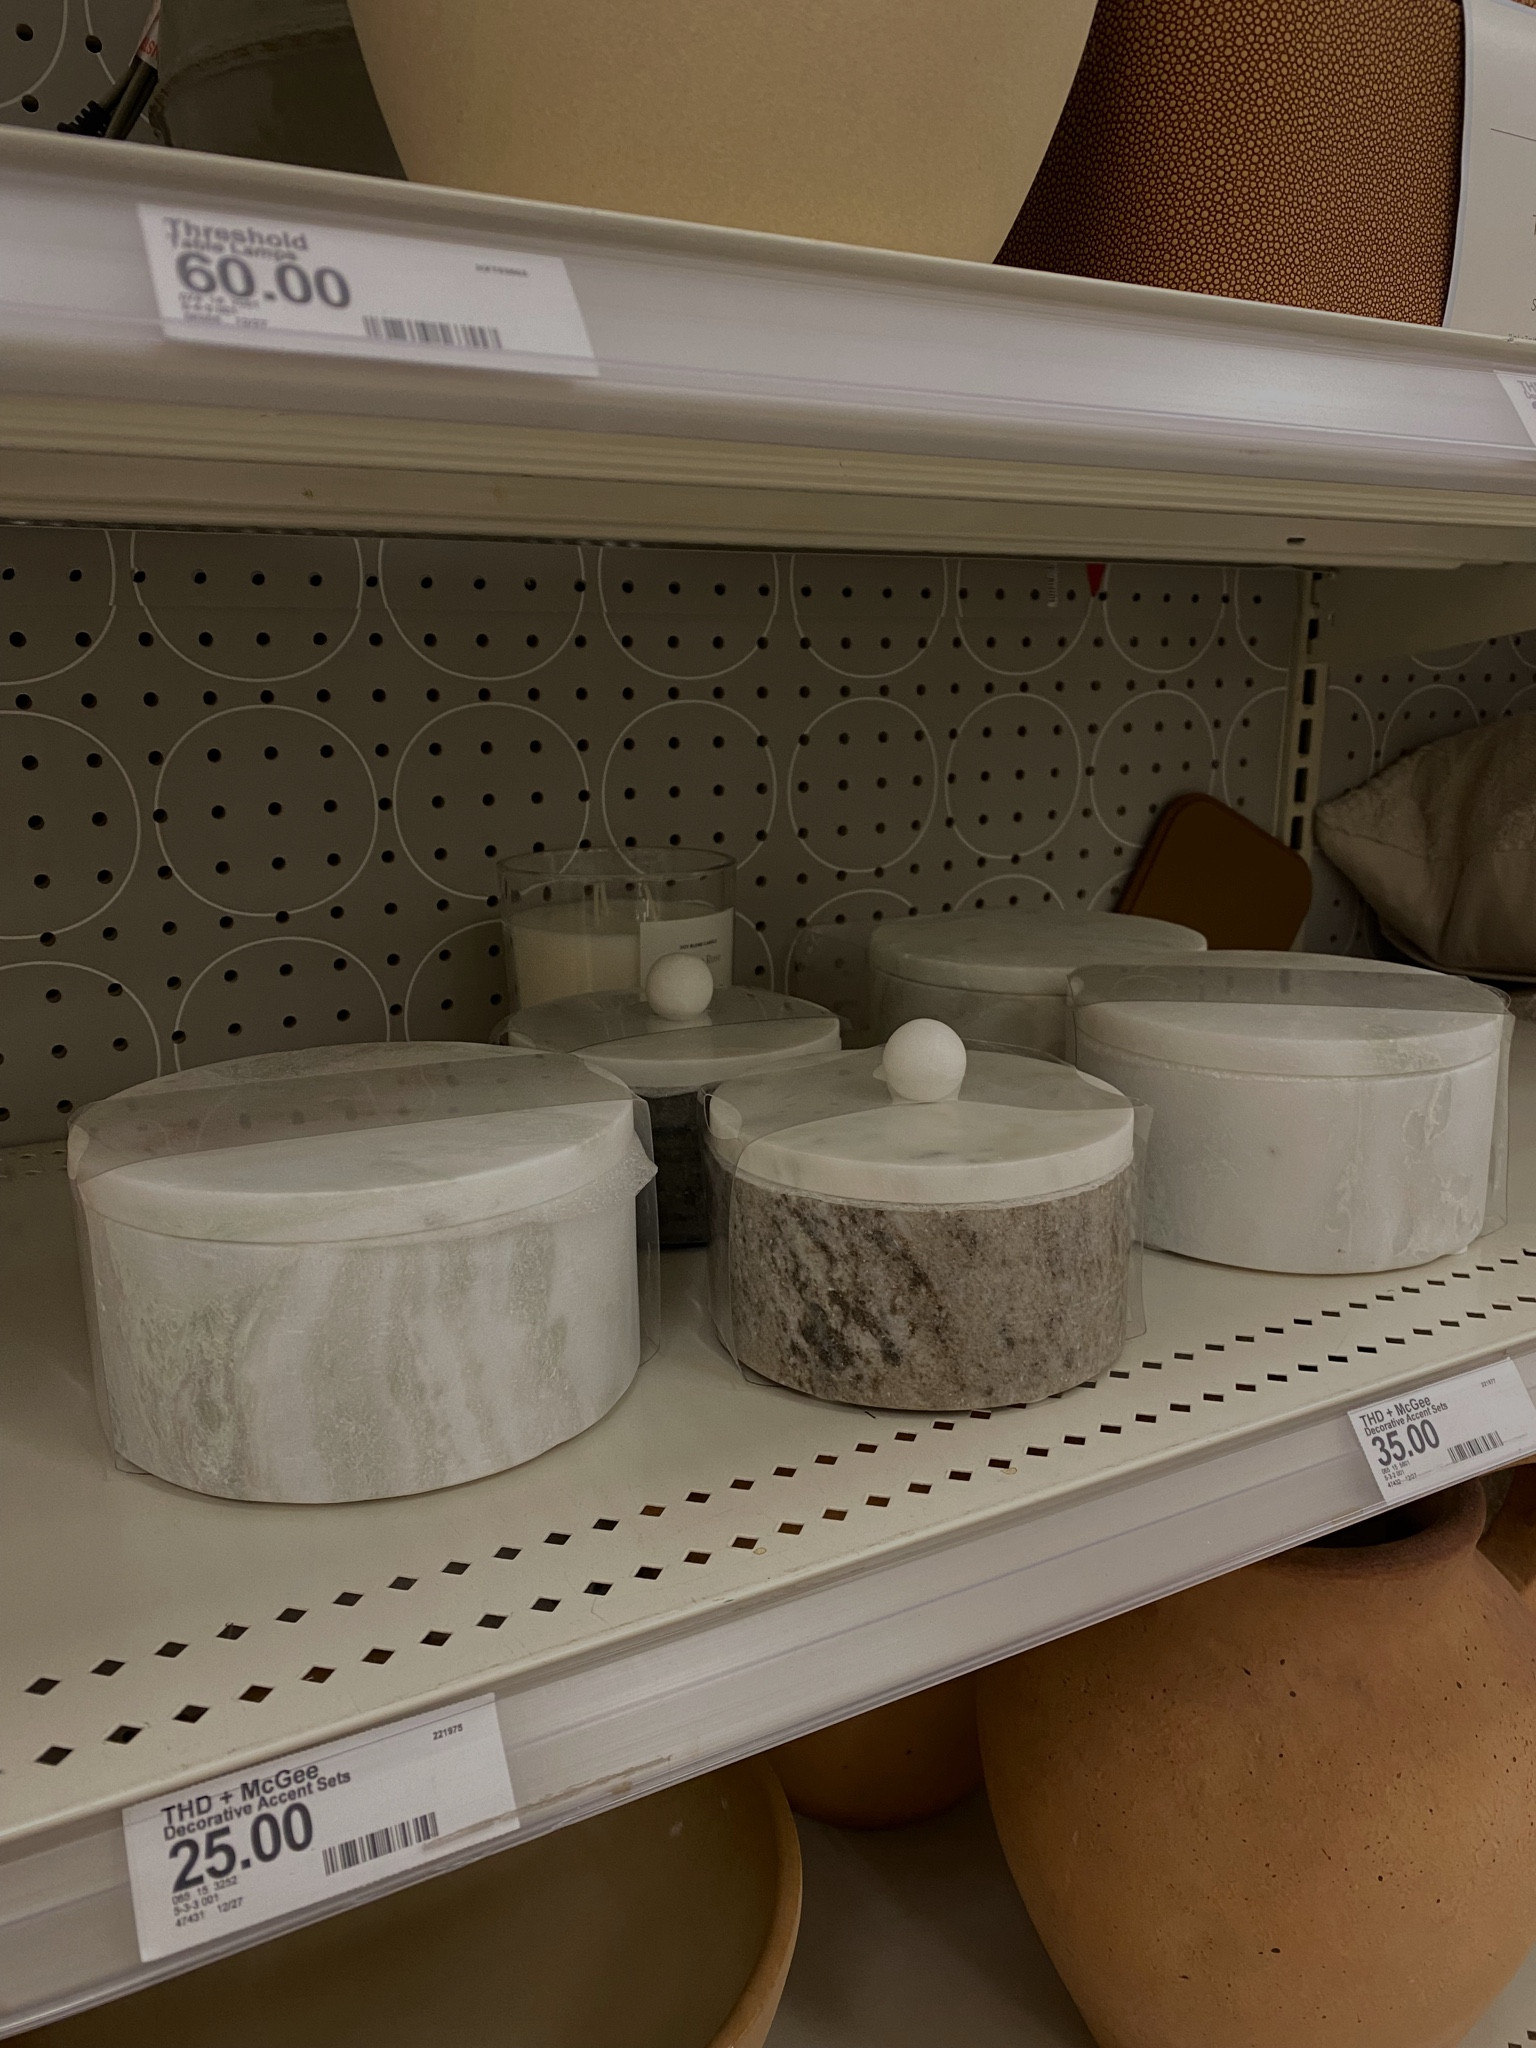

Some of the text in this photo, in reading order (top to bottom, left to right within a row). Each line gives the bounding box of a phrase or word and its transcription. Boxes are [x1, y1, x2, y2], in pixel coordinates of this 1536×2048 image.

[164, 217, 308, 251] Threshold
[176, 252, 351, 308] 60.00
[1359, 1396, 1431, 1428] THD + McGee
[1364, 1402, 1448, 1437] Decorative Accent Sets
[1371, 1418, 1440, 1467] 35.00
[432, 1723, 464, 1741] 221975
[161, 1765, 319, 1826] THD + McGee
[163, 1771, 351, 1842] Decorative Accent Sets
[169, 1802, 313, 1894] 25.00
[175, 1896, 243, 1927] 47431 12/27
[201, 1893, 219, 1907] 001
